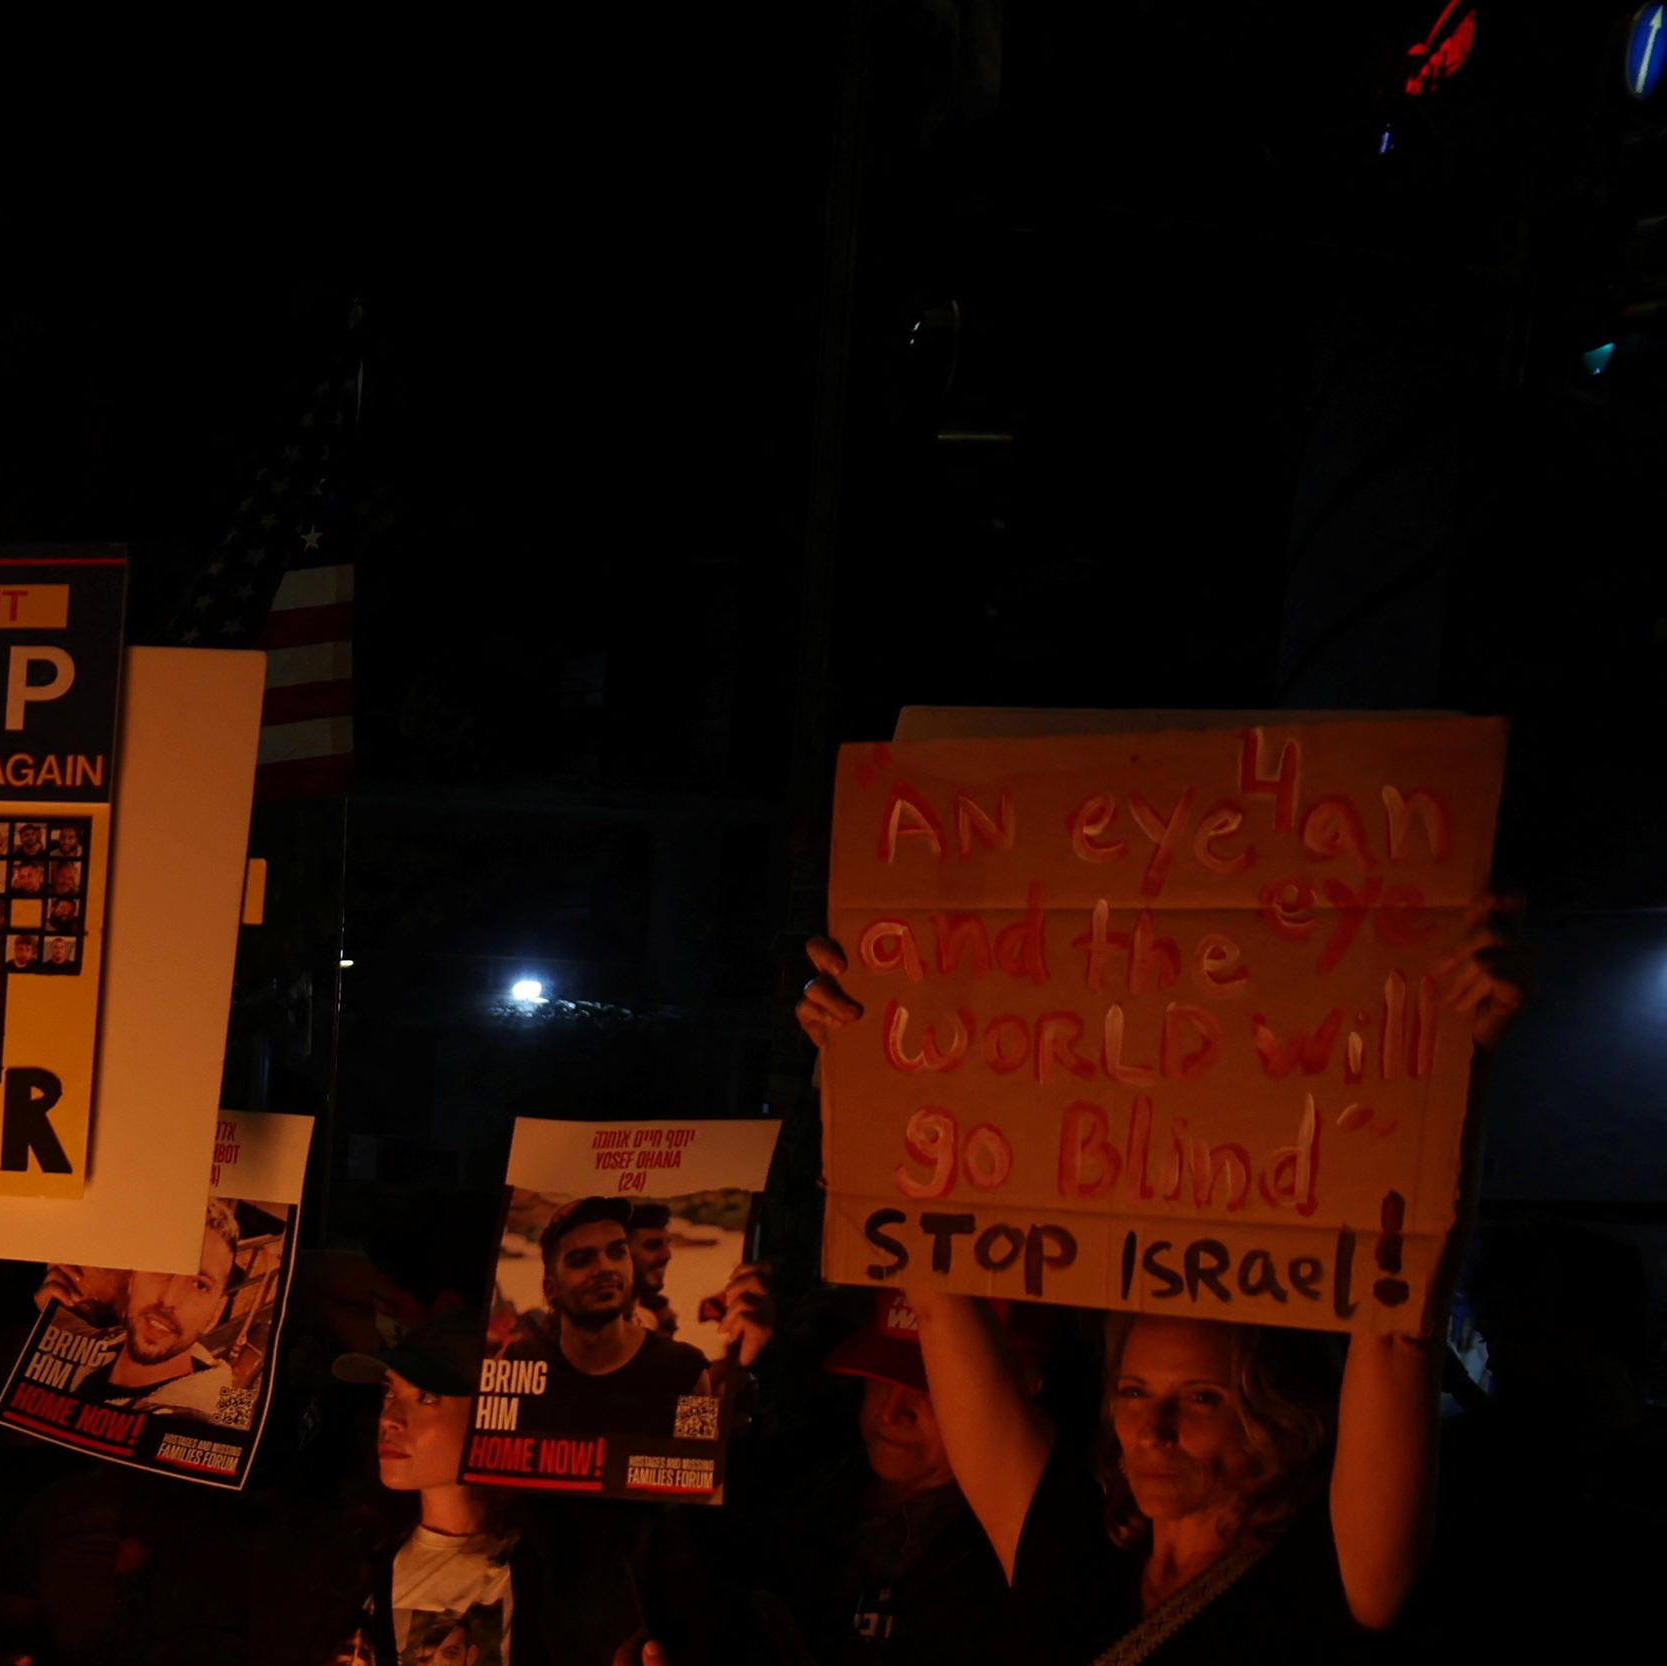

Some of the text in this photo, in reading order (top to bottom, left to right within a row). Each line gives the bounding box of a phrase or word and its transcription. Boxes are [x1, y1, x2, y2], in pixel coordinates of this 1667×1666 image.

[1238, 726, 1301, 834] 4
[1068, 787, 1257, 896] eye
[1301, 785, 1452, 867] an
[860, 879, 1249, 994] and the
[1261, 875, 1435, 971] eye
[1253, 968, 1438, 1084] will
[592, 1129, 696, 1149] יוסף חיים אוחנה
[595, 1150, 682, 1170] YOSEF OHANA
[898, 1106, 1012, 1199] go
[618, 1171, 647, 1193] (24)
[865, 1208, 1077, 1296] STOP
[38, 1325, 117, 1366] BRING
[24, 1351, 74, 1391] HIM
[479, 1358, 549, 1395] BRING
[9, 1381, 148, 1446] HOME NOW!
[475, 1396, 520, 1431] HIM
[158, 1441, 240, 1471] FAMILIES FORUM
[468, 1434, 608, 1477] HOME NOW!
[627, 1467, 714, 1489] FAMILIES FORUM
